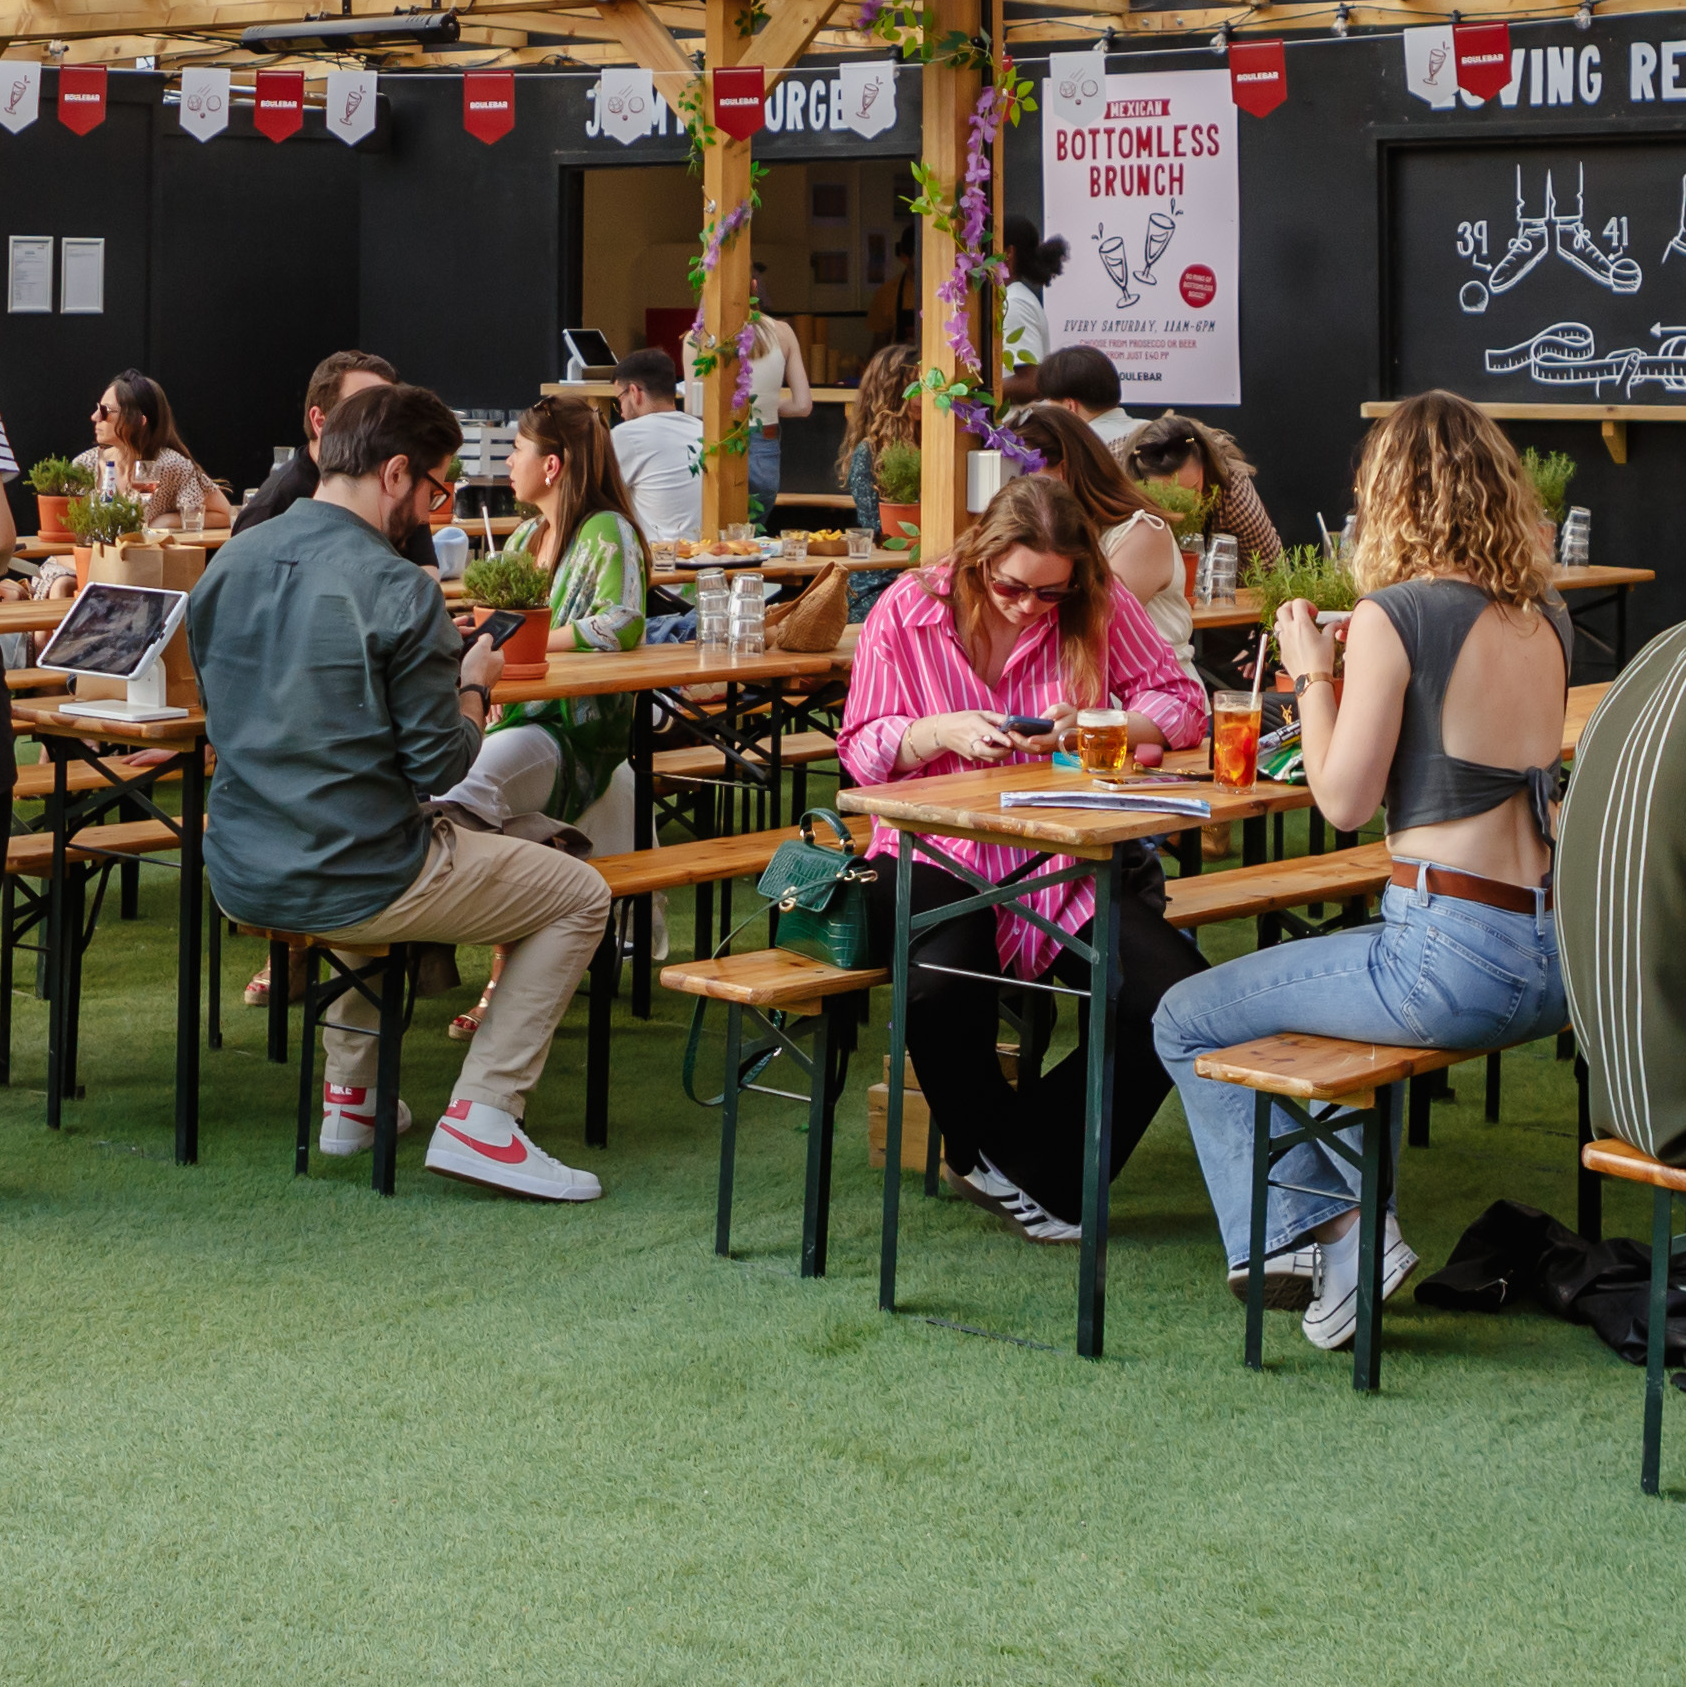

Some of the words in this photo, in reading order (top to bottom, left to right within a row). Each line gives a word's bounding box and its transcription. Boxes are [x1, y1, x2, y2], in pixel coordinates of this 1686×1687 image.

[1462, 53, 1504, 65] BOULEBAR
[1237, 71, 1279, 82] BOULEBAR
[1429, 44, 1602, 109] VING
[64, 93, 100, 101] BOULEBAR
[720, 97, 759, 106] BOULEBAR
[261, 100, 297, 108] BOULEBAR
[470, 101, 508, 109] BOULEBAR
[764, 78, 897, 134] URGE
[1110, 101, 1163, 117] MEXICAN
[1057, 124, 1220, 161] BOTTOMLESS
[1090, 164, 1184, 197] BRUNCH
[1601, 215, 1630, 247] 41
[1456, 220, 1489, 256] 39
[1063, 319, 1098, 333] EVERY
[1101, 319, 1158, 334] SATURDAY,
[1164, 319, 1216, 333] 11AM-6PM
[1108, 339, 1128, 349] FROM
[1129, 339, 1165, 349] PROSECCO
[1167, 339, 1178, 349] OR
[1178, 339, 1197, 349] BEER
[1126, 351, 1143, 360] JUST
[1118, 372, 1163, 382] OULEBAR
